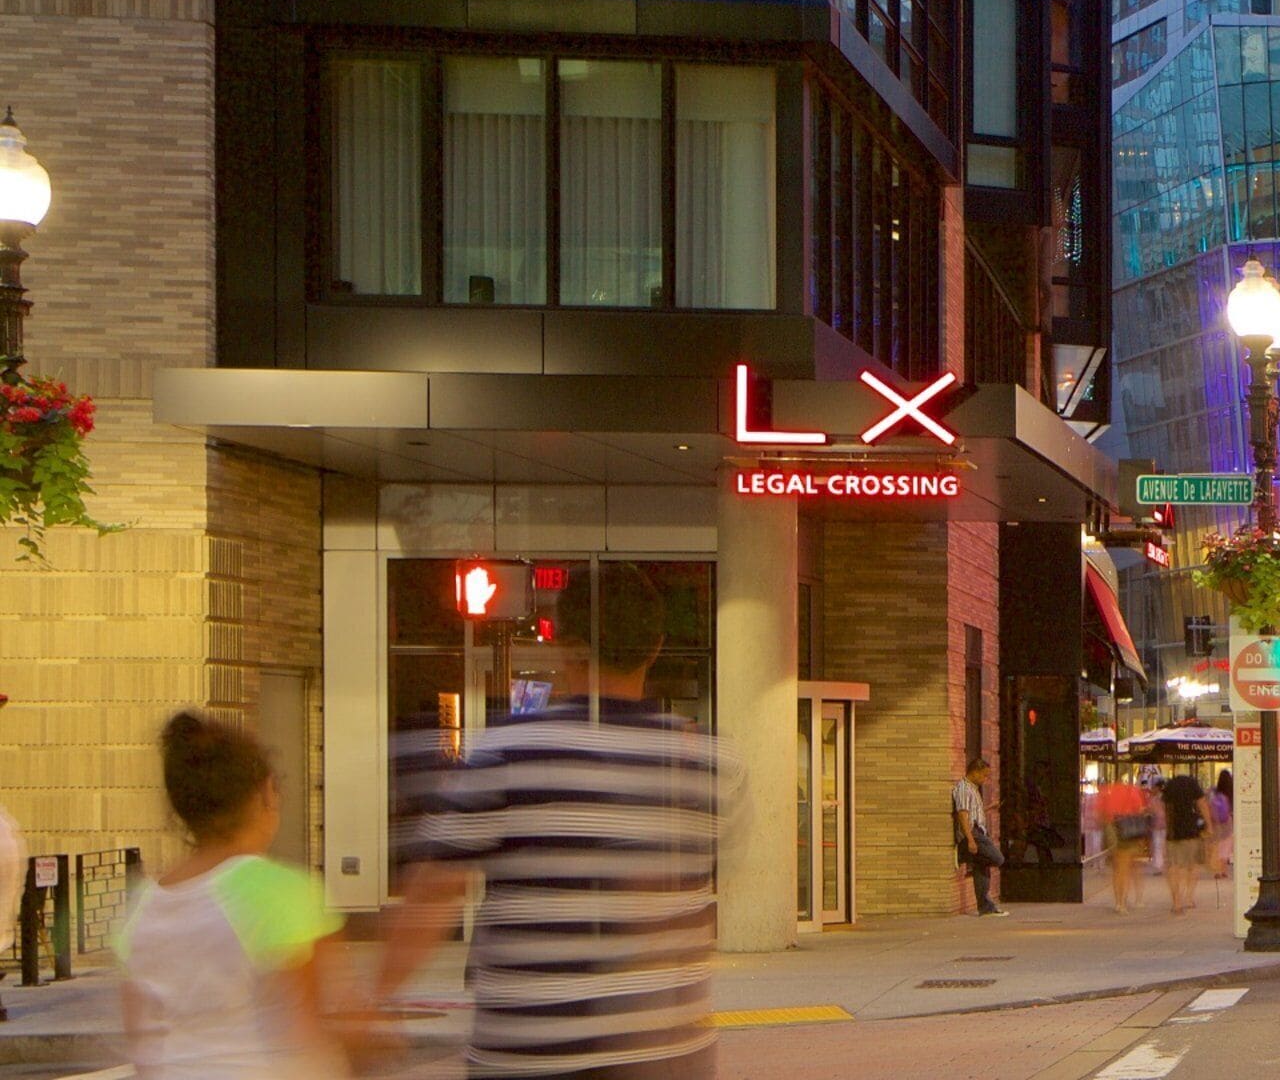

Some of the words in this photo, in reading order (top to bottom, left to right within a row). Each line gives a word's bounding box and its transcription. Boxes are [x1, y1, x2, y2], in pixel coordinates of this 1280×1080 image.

[737, 474, 819, 495] LEGAL
[827, 475, 958, 496] CROSSING
[1142, 480, 1178, 500] AVENUE
[1183, 481, 1196, 500] De
[1200, 481, 1249, 501] LAFAYETTE
[1246, 653, 1262, 665] DO
